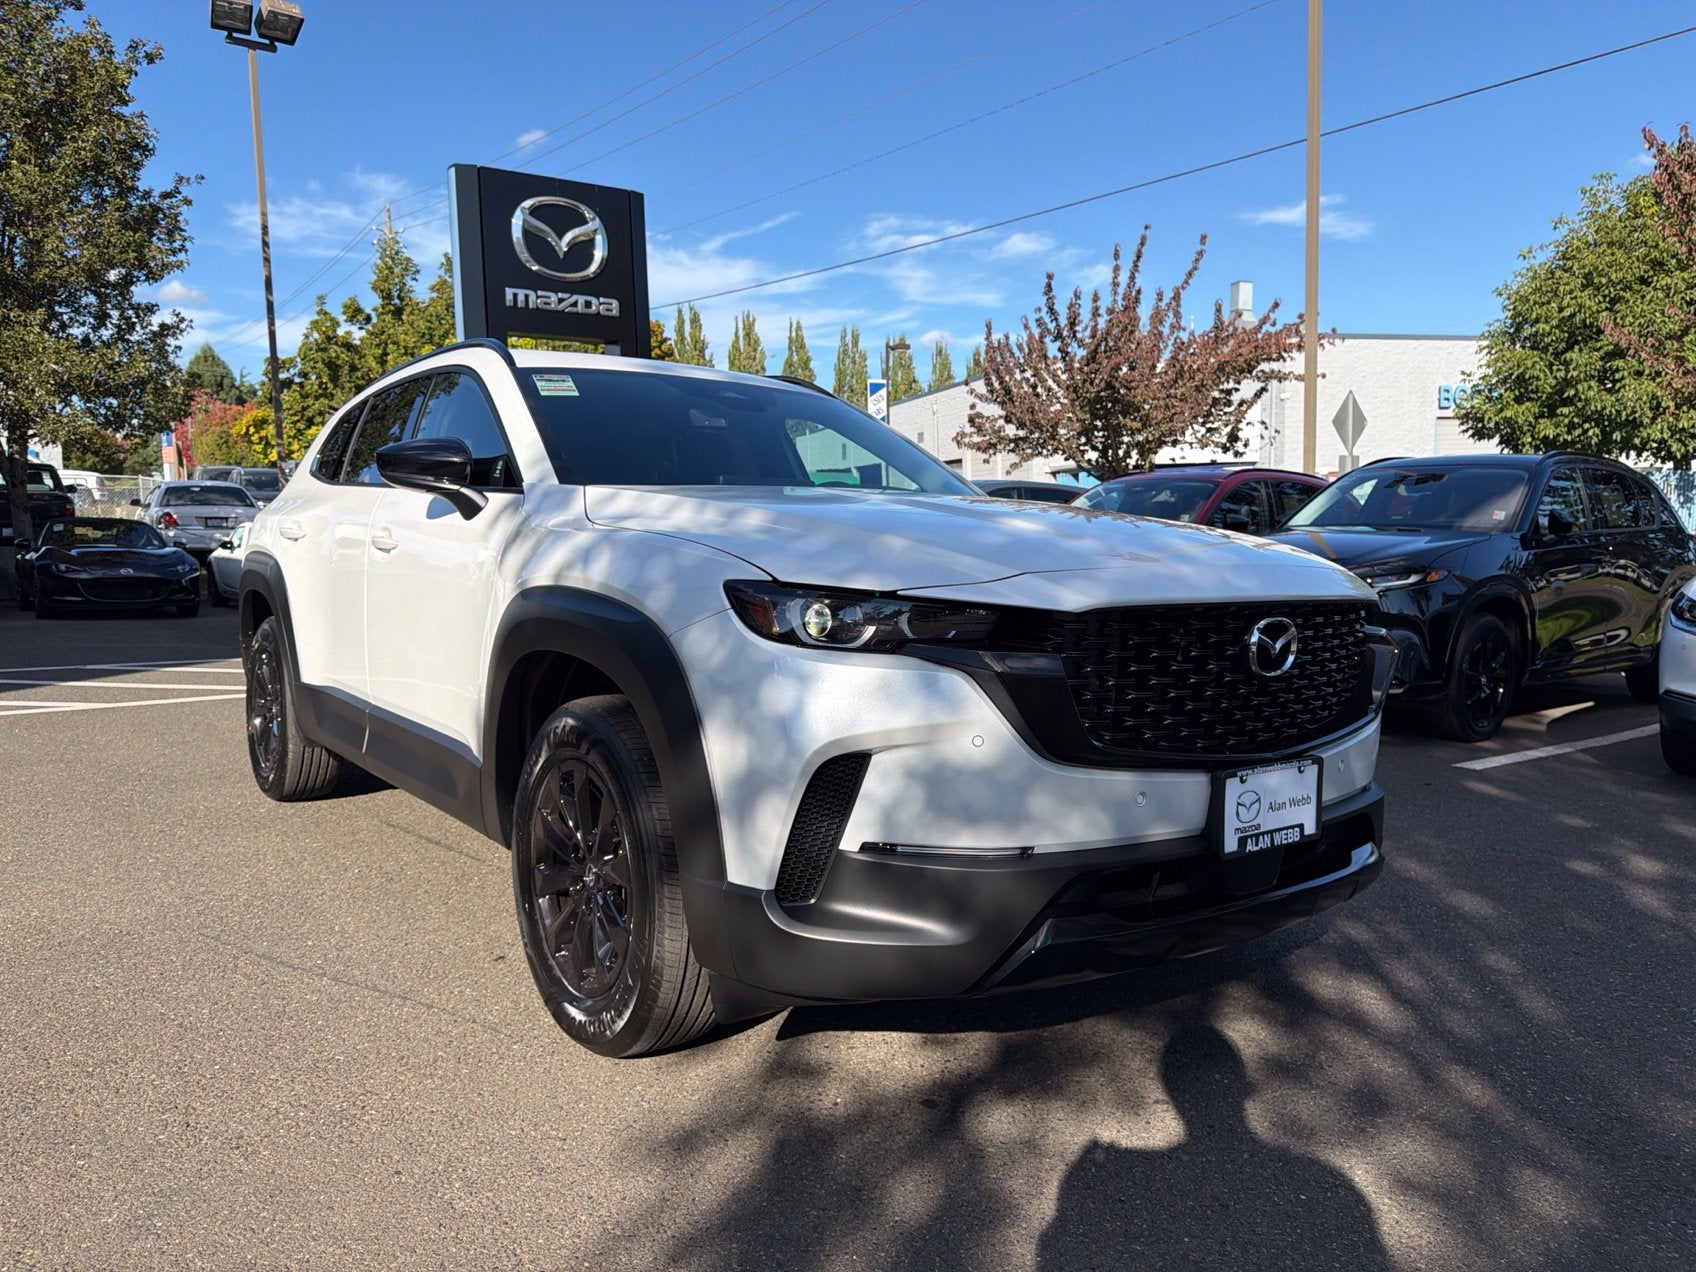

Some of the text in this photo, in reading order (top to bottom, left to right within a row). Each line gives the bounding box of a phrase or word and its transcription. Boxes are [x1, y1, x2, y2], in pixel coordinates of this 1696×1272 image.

[1236, 759, 1313, 777] www.alanwebbmazda.com
[1267, 793, 1312, 813] Alan Webb
[1246, 827, 1300, 853] ALAN WEBB
